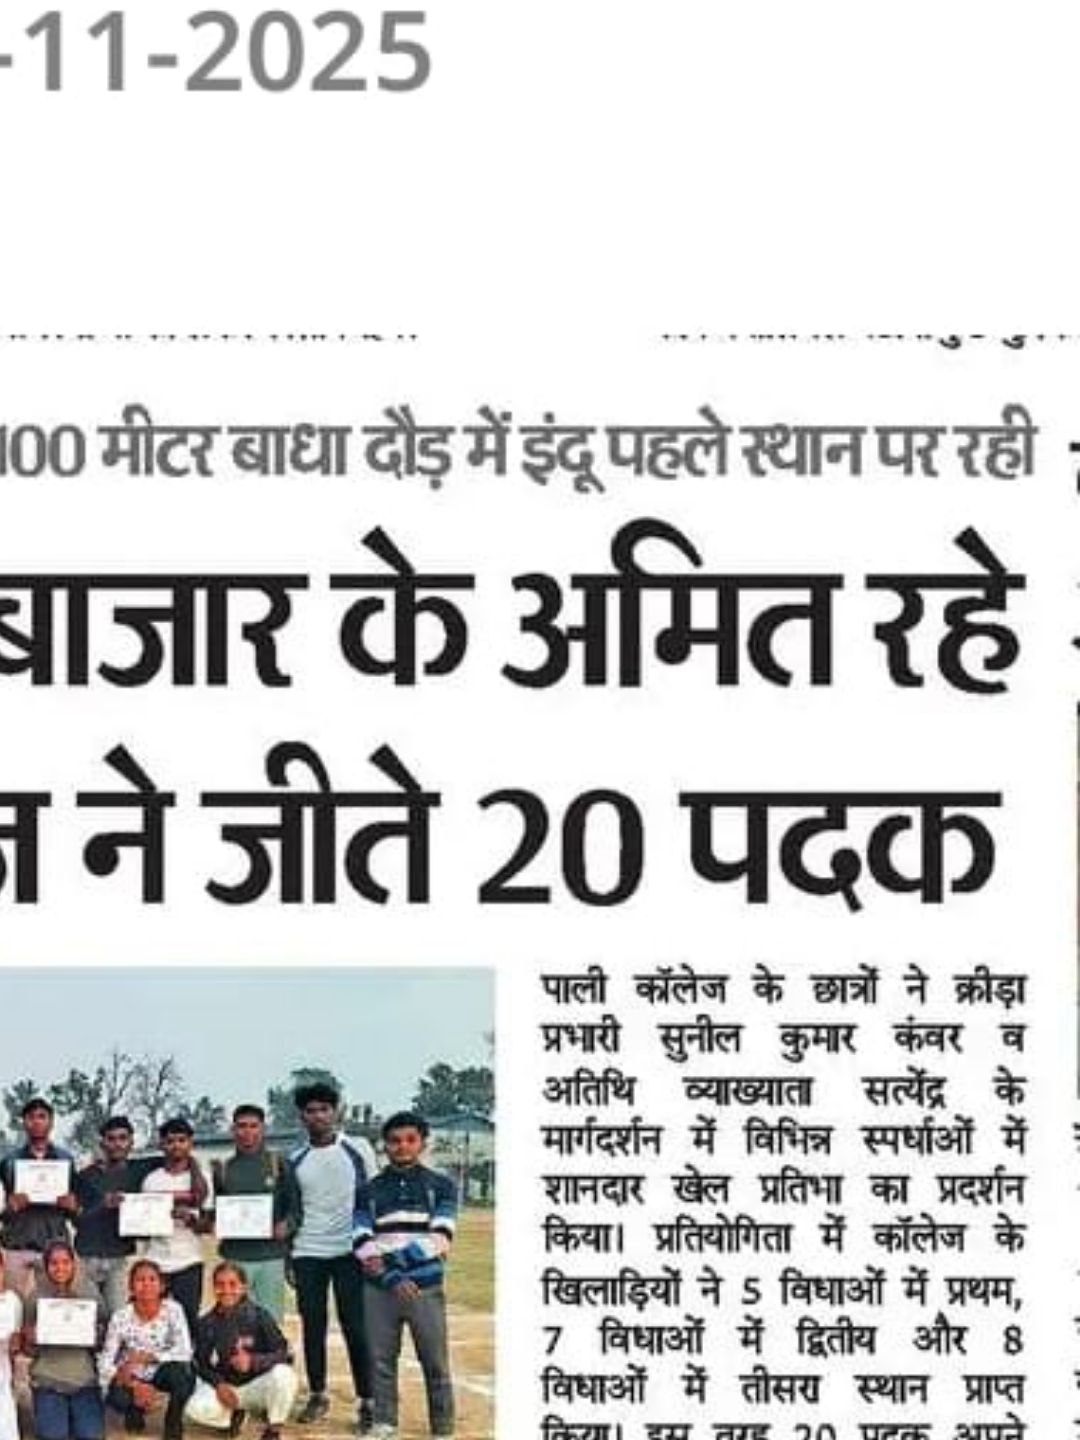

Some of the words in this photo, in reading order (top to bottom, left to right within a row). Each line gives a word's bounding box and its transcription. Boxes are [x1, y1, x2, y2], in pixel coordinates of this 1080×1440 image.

[97, 404, 221, 477] मीटर
[228, 423, 352, 475] बाधा
[362, 405, 455, 489] दौड़
[463, 406, 511, 475] में
[519, 406, 602, 493] इंदू
[606, 406, 734, 480] पहले
[739, 424, 867, 477] स्थान
[875, 426, 947, 477] पर
[953, 404, 1038, 480] रही
[330, 526, 475, 686] के
[501, 518, 844, 688] अमित
[865, 526, 1026, 694] रहे
[76, 744, 176, 903] ने
[200, 741, 441, 905] जीते
[478, 789, 644, 906] 20
[679, 792, 1002, 912] पदक
[541, 965, 608, 1004] पाली
[633, 963, 729, 1004] कॉलेज
[752, 963, 785, 1003] के
[810, 963, 879, 1003] छात्रों
[903, 963, 929, 1004] ने
[953, 965, 1028, 1009] क्रीड़ा
